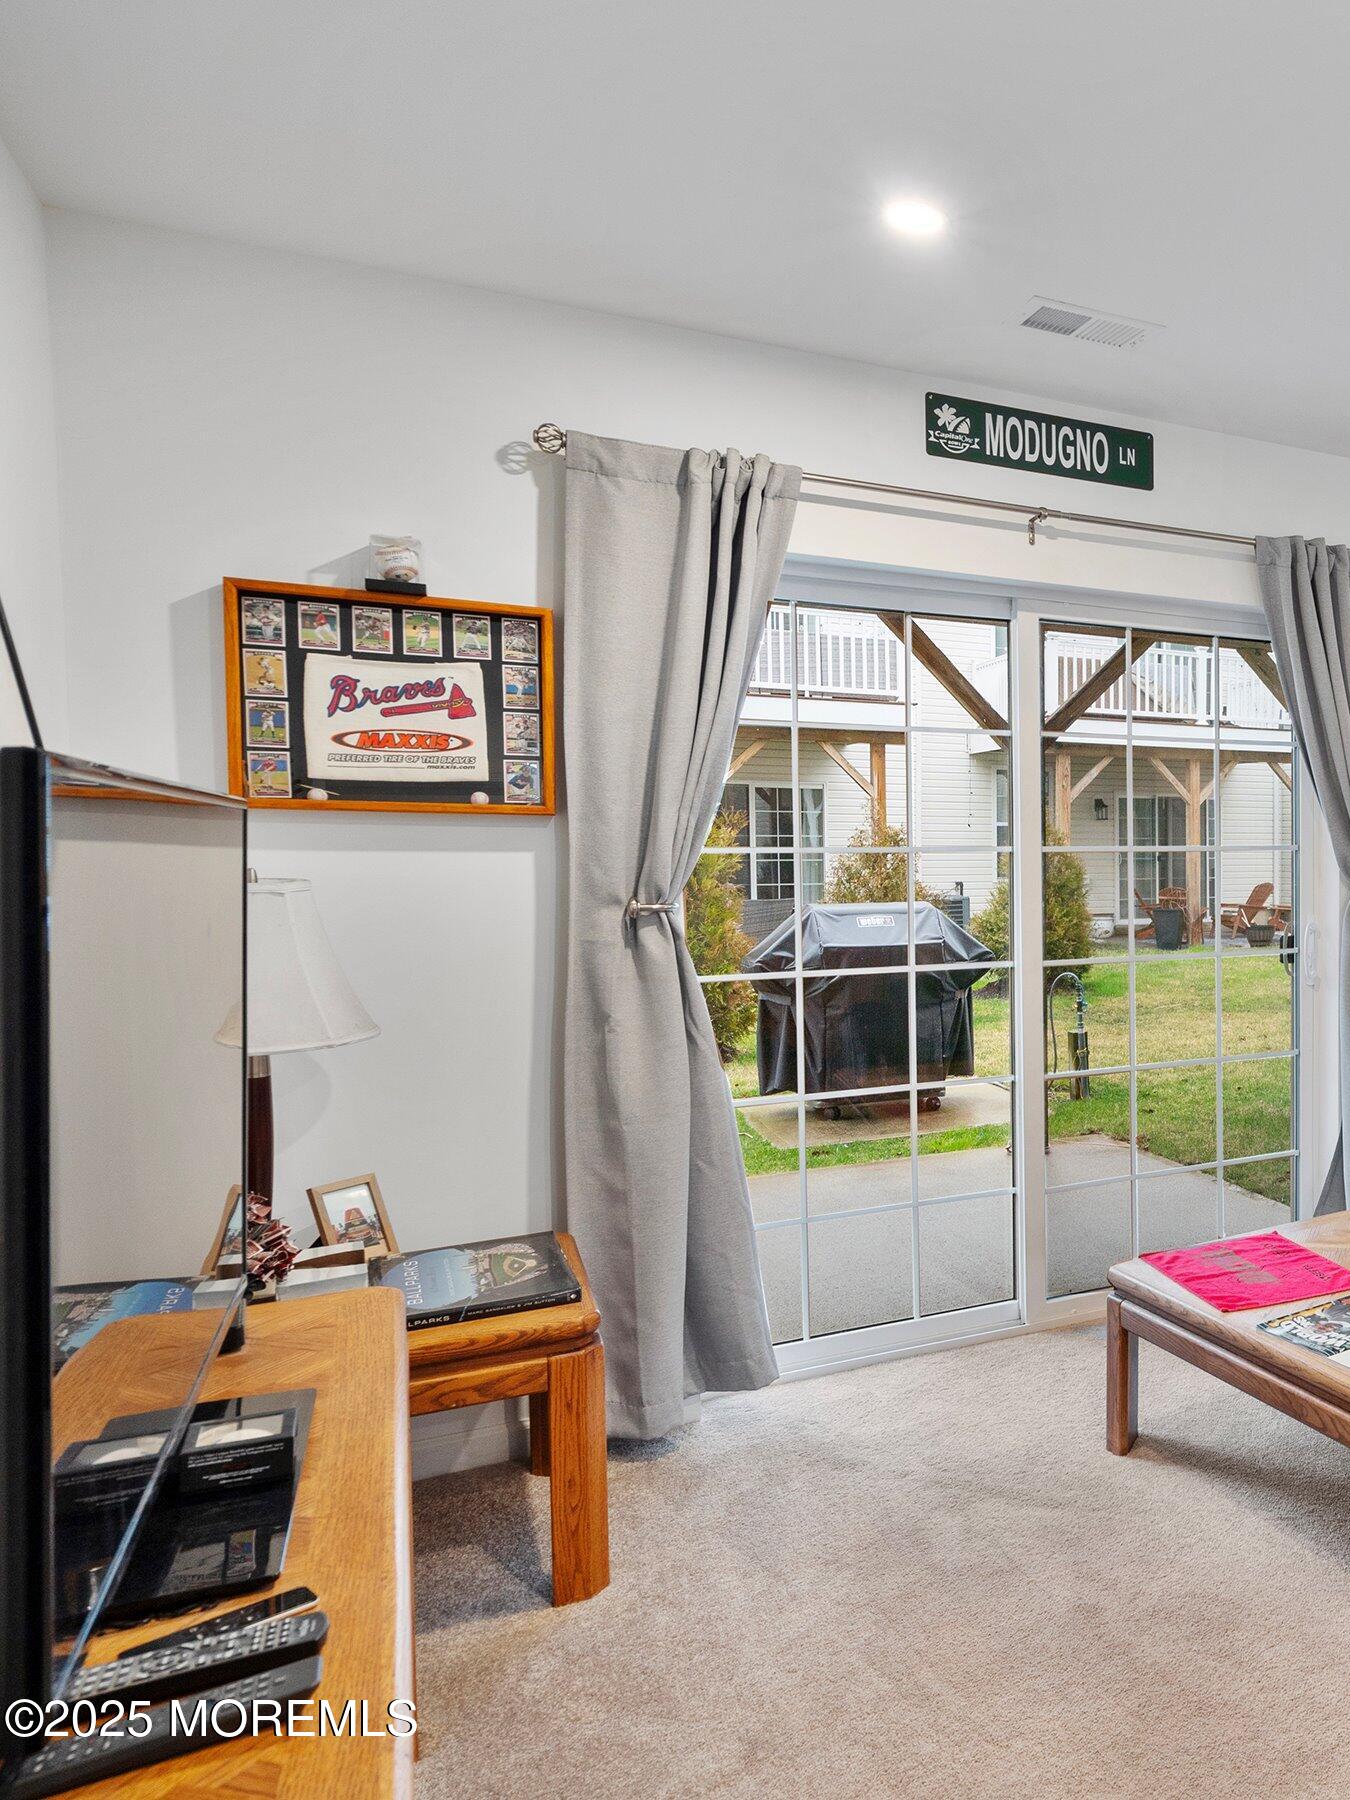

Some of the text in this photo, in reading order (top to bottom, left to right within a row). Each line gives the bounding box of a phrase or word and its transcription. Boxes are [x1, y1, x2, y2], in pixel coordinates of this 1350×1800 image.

[985, 413, 1136, 474] MODUGNO LN
[327, 674, 447, 718] Braves
[327, 753, 476, 764] PREFERRED TIRE OF THE BRAVES
[356, 731, 450, 750] MAXXIS
[403, 1260, 423, 1306] BALLPARKS
